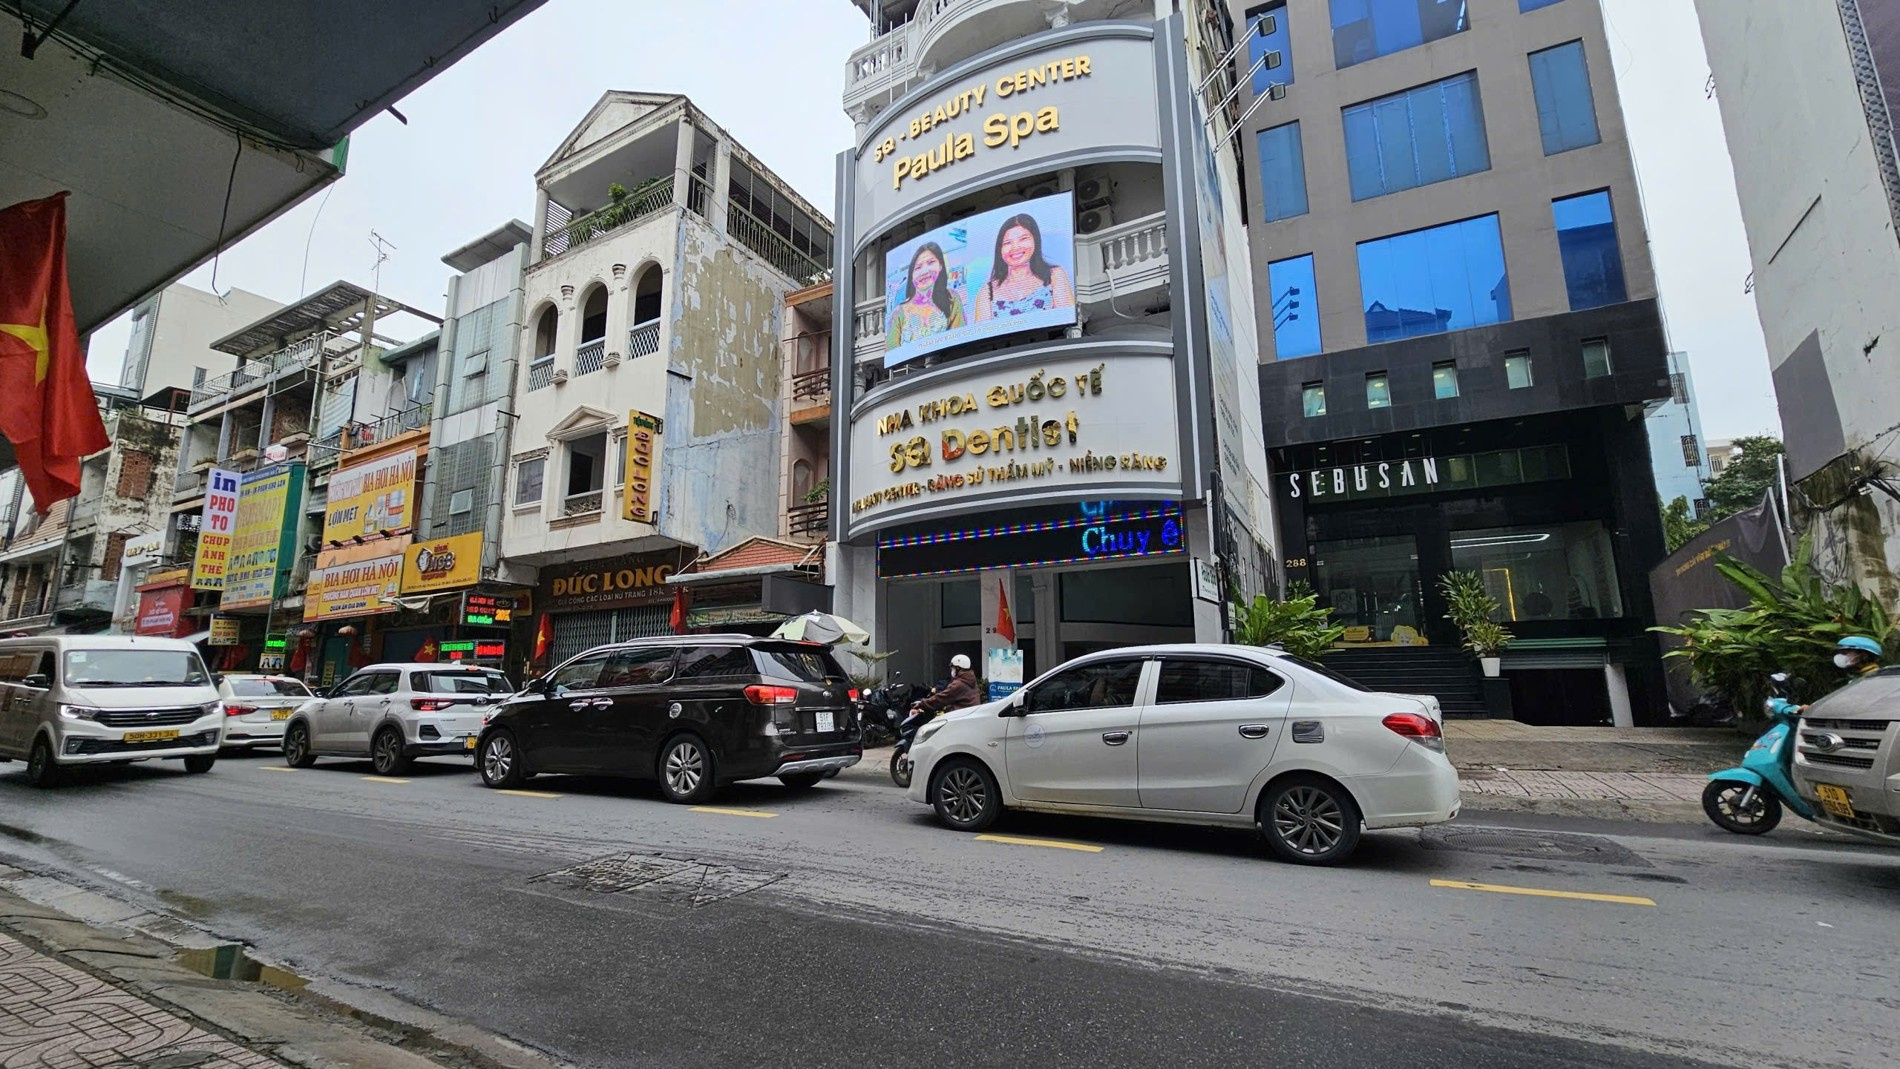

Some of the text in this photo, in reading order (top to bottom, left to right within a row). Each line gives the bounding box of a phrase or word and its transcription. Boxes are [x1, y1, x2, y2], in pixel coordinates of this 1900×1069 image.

[874, 135, 897, 163] SQ
[908, 84, 988, 140] BEAUTY
[995, 55, 1093, 98] CENTER
[892, 105, 1061, 191] Paula Spa
[876, 362, 1106, 438] NHA KHOA QUỐC TẾ
[888, 410, 1080, 474] SQ Dentist
[213, 472, 237, 492] in
[363, 472, 374, 493] BIA
[375, 467, 389, 490] HƠI
[389, 458, 399, 486] HÀ
[400, 456, 415, 487] NỘI
[883, 481, 921, 501] CENTER
[1120, 451, 1168, 472] RĂNG
[1289, 457, 1439, 498] SEBUSAN
[209, 495, 236, 513] PHO
[211, 514, 229, 531] TO
[201, 546, 226, 561] ẢNH
[202, 534, 230, 549] CHỤP
[200, 562, 223, 575] THẺ
[324, 572, 339, 588] BIA
[341, 568, 360, 585] HƠI
[362, 562, 377, 581] HÀ
[379, 558, 399, 582] NỘI
[1286, 558, 1307, 568] 288
[553, 571, 598, 596] ĐỨC
[603, 565, 673, 591] LONG
[625, 590, 646, 599] TRANG
